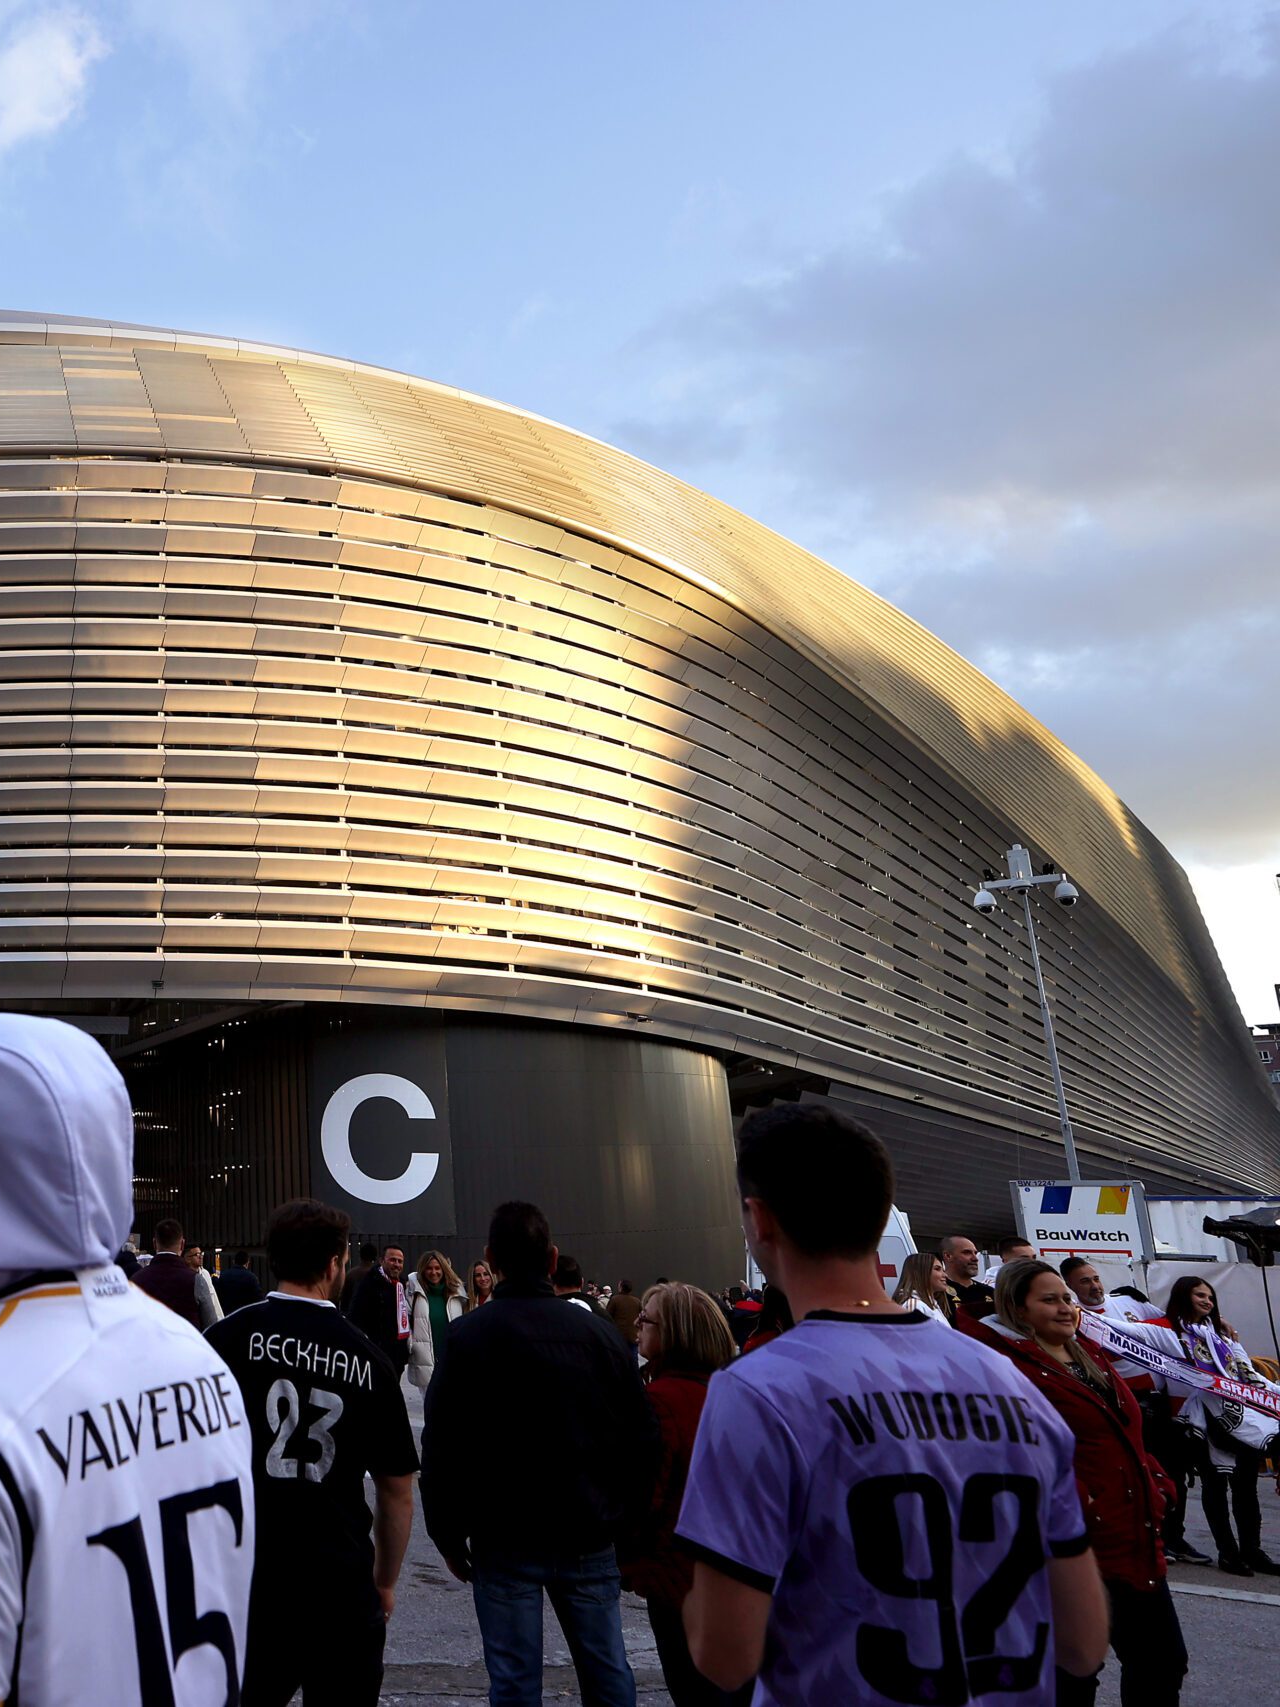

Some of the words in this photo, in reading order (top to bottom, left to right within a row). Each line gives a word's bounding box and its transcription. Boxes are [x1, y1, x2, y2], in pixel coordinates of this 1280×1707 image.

[320, 1073, 439, 1205] C
[1036, 1229, 1129, 1242] BauWatch
[248, 1333, 373, 1391] BECKHAM
[1109, 1332, 1163, 1366] MADRID
[36, 1371, 241, 1482] VALVERDE
[264, 1378, 344, 1483] 23
[86, 1478, 244, 1707] 15
[846, 1473, 1048, 1706] 92
